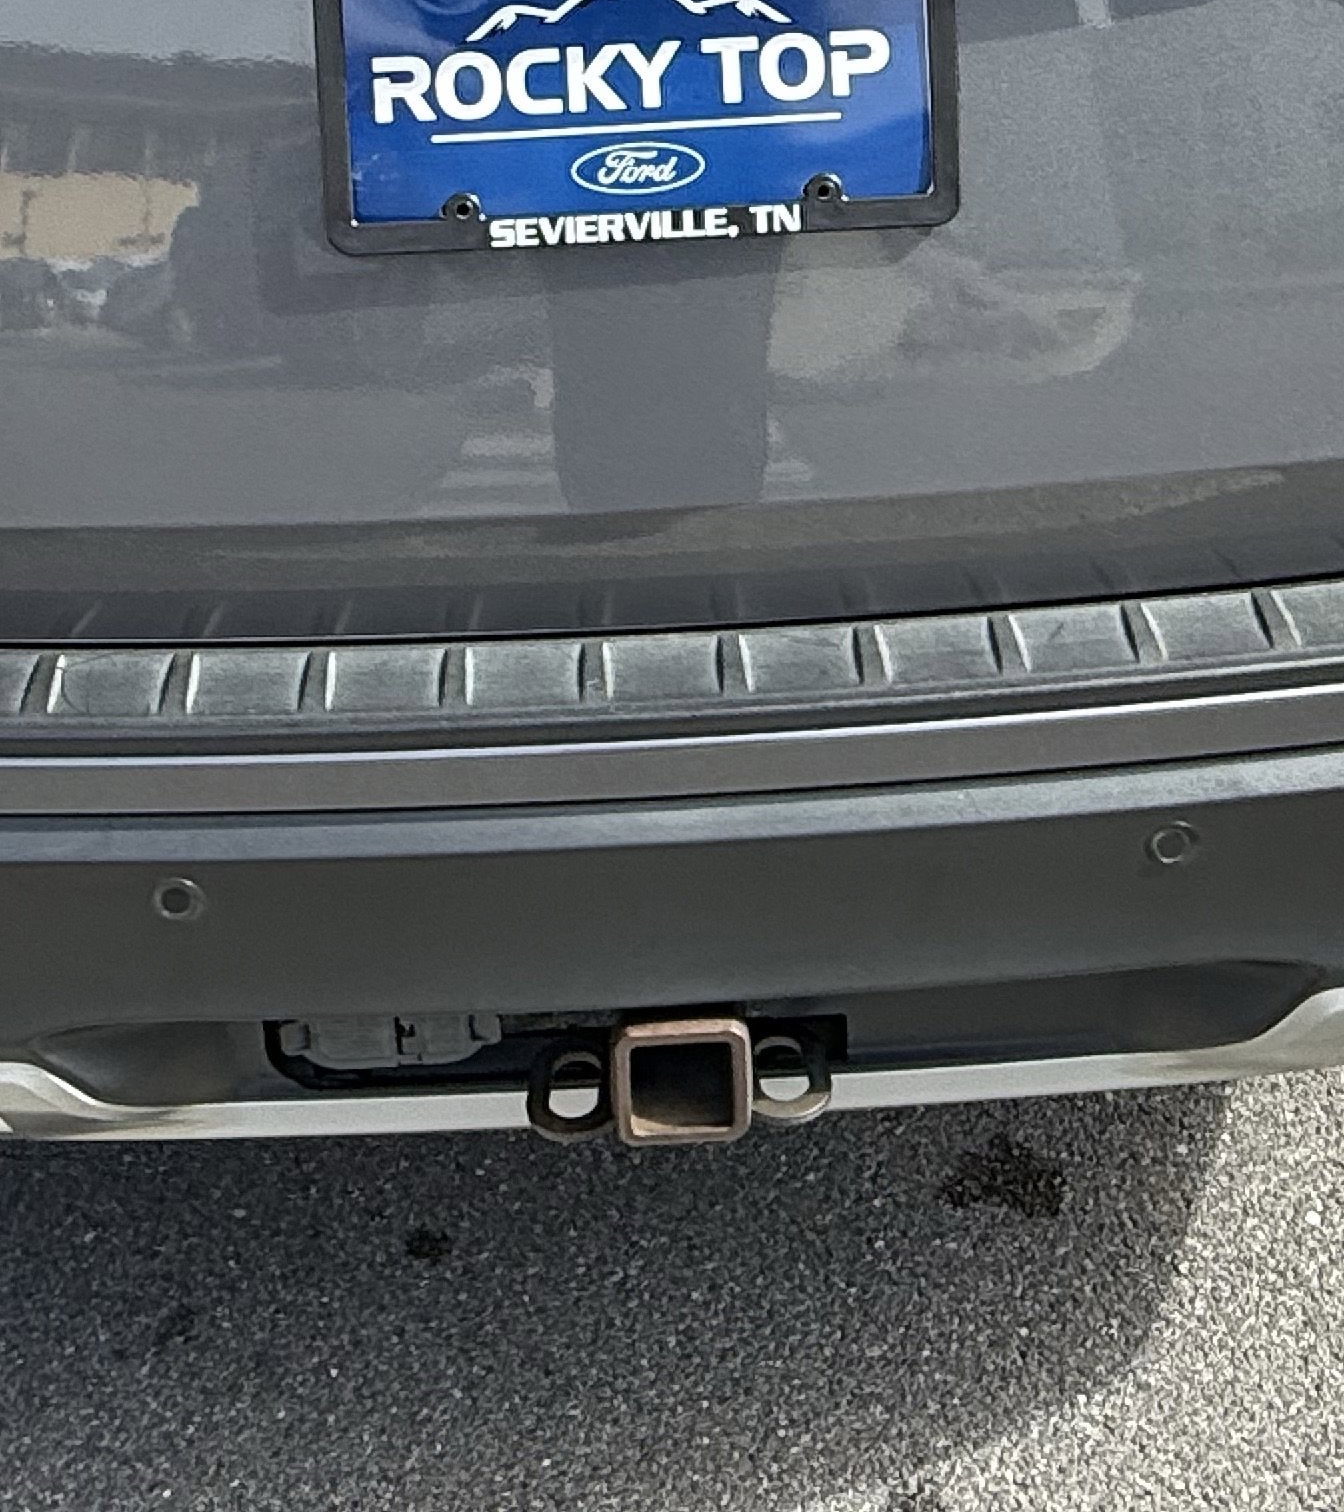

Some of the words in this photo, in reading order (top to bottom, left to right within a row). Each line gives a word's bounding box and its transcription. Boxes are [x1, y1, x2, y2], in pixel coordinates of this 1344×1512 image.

[370, 39, 682, 124] ROCKY
[700, 29, 891, 104] TOP
[598, 151, 679, 186] Ford
[489, 206, 739, 249] SEVIERVILLE,
[751, 203, 802, 234] TN
